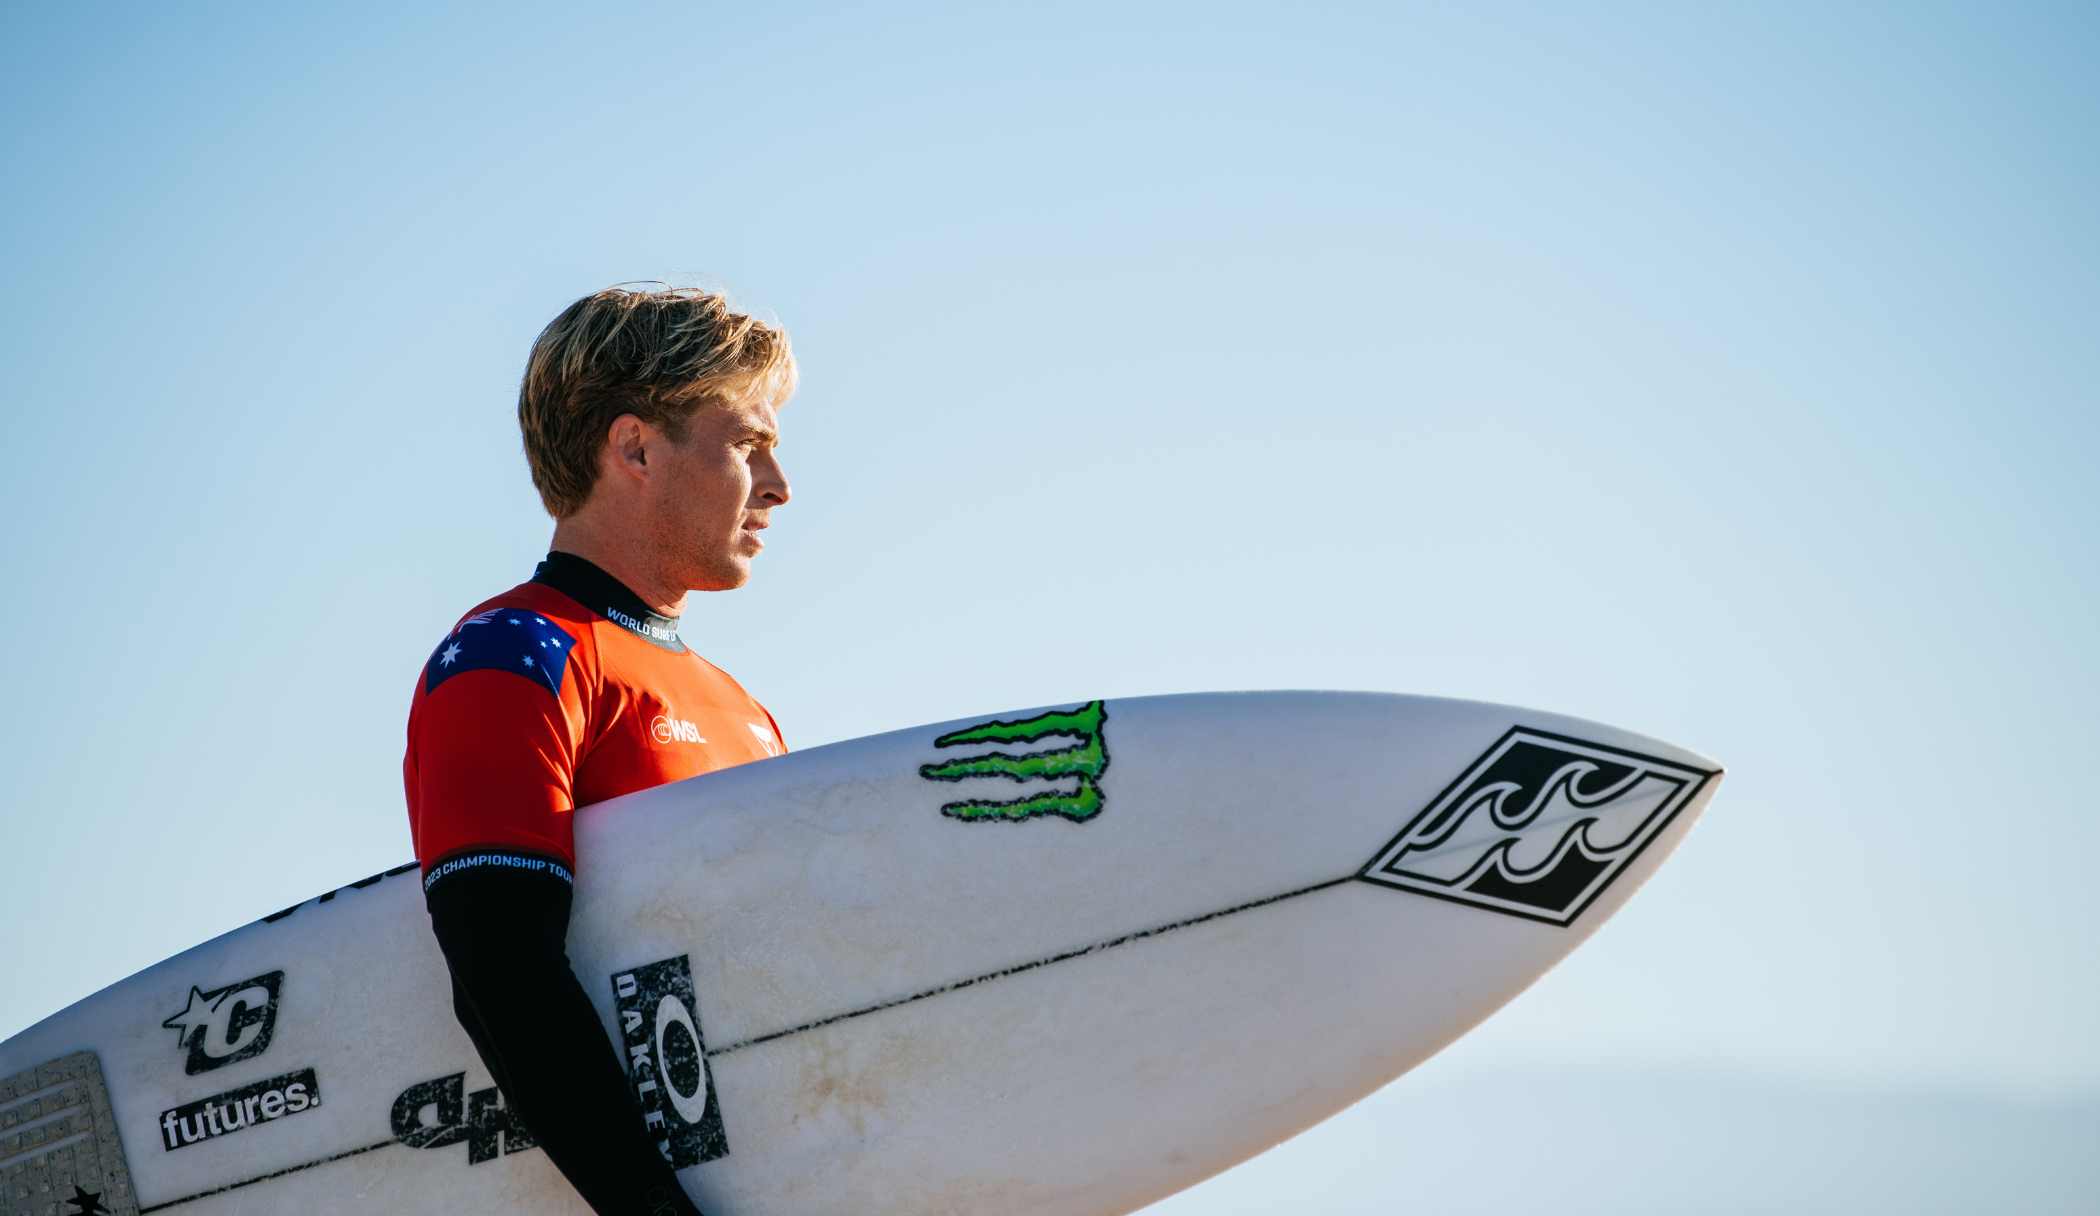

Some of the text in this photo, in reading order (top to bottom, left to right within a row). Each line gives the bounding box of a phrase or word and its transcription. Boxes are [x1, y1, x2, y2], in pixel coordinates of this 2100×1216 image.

[607, 606, 650, 635] WORLD
[668, 718, 707, 743] WSL
[443, 855, 546, 875] CHAMPIONSHIP
[162, 1081, 320, 1148] futures.
